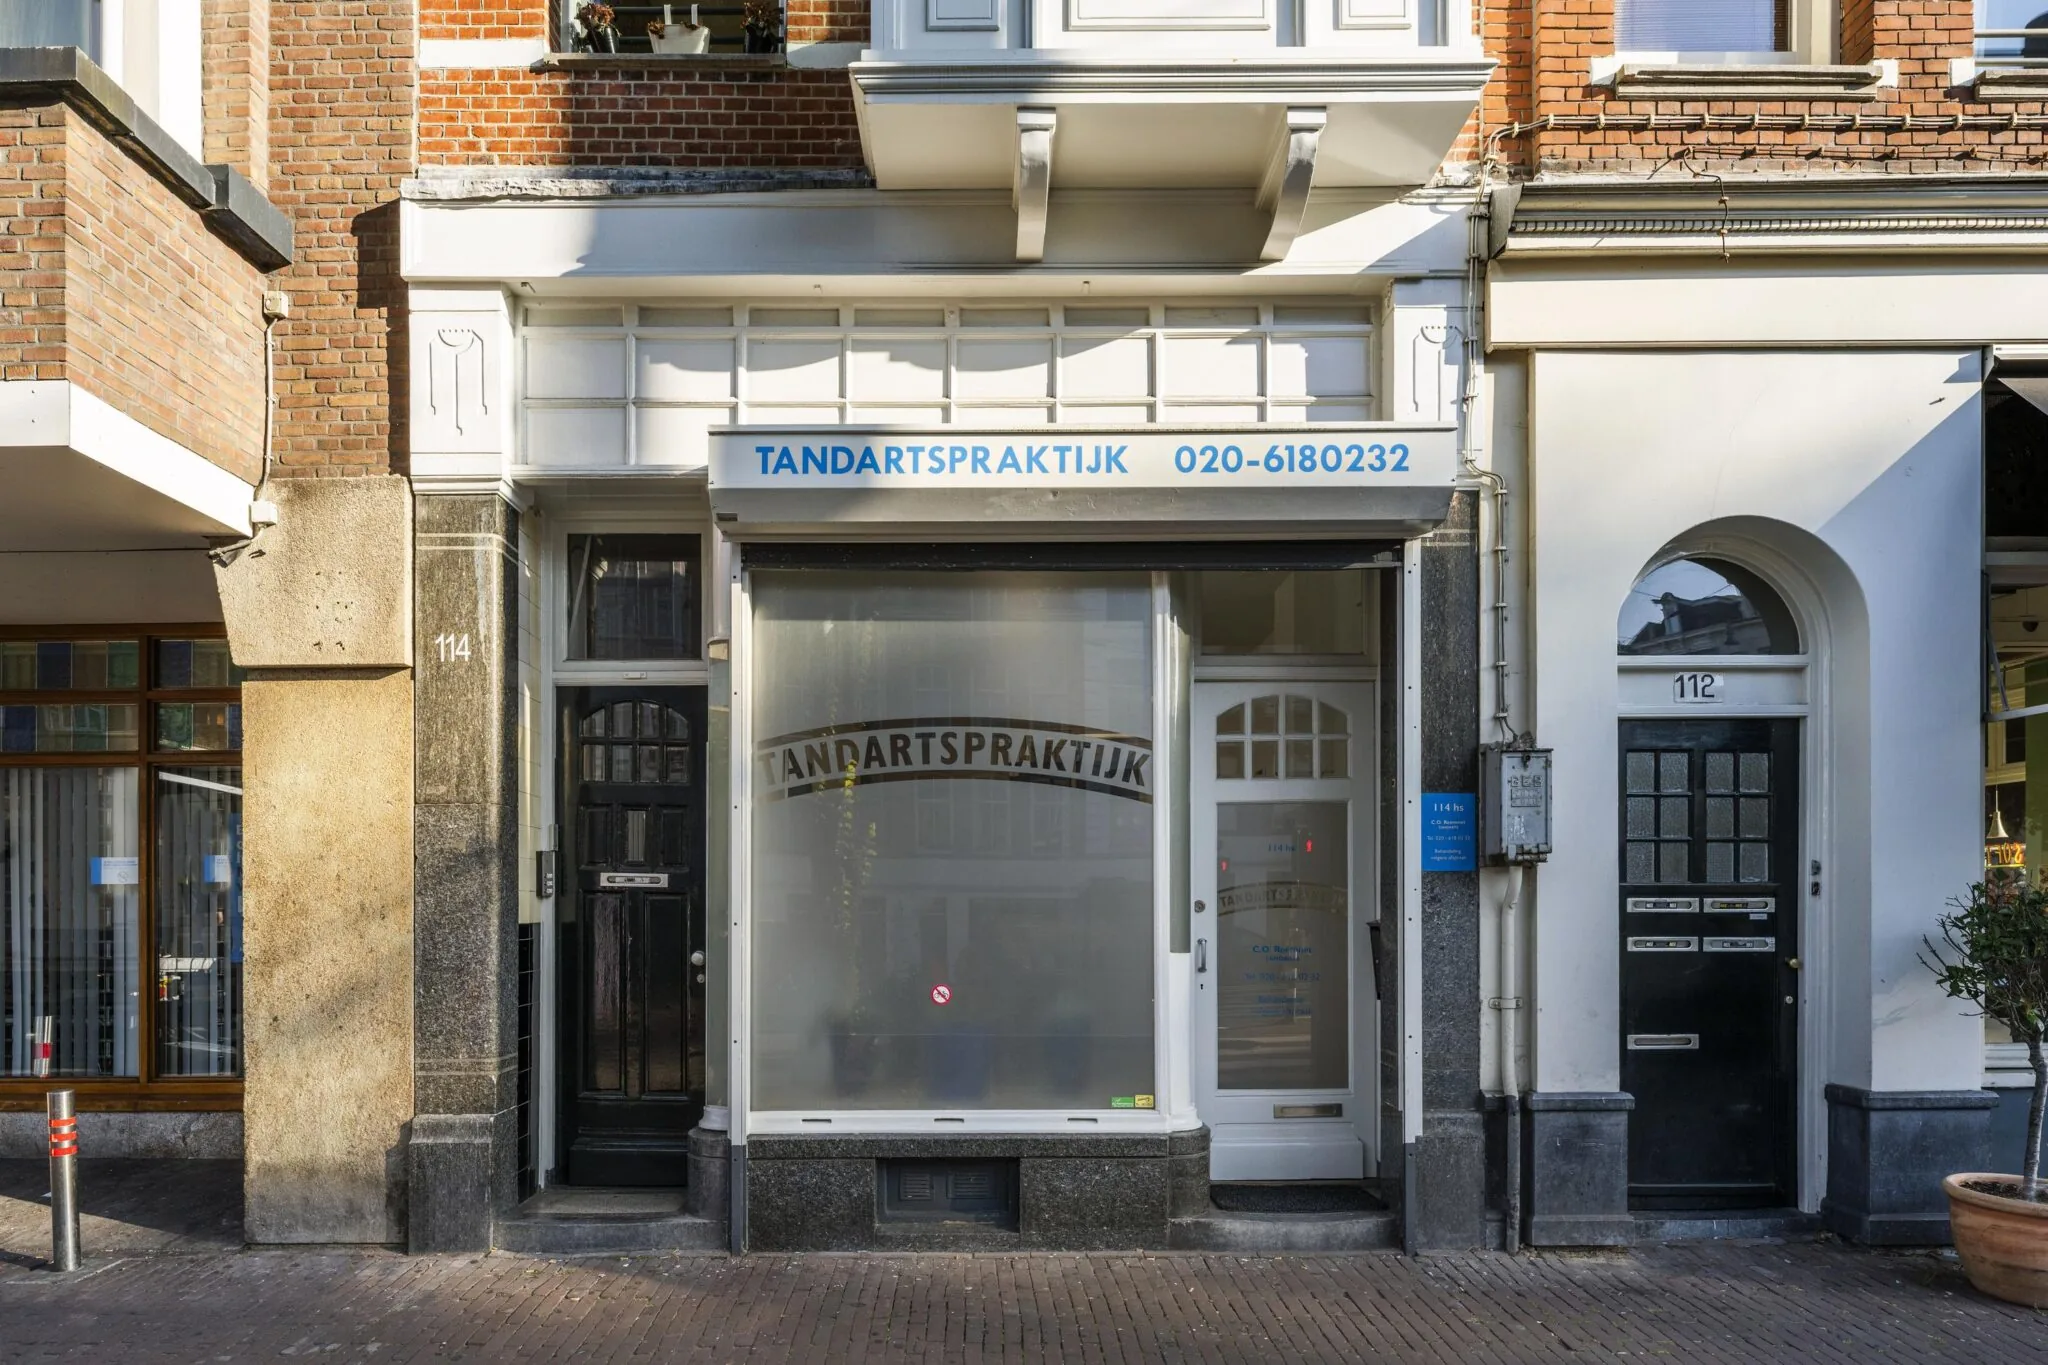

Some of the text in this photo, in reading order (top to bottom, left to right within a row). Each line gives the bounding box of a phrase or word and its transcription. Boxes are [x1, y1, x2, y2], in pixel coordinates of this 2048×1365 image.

[755, 443, 1410, 475] TANDARTSPRAKTIJK 020-6180232
[435, 633, 472, 662] 114
[1675, 674, 1715, 698] 112
[757, 731, 1151, 787] TANDARTSPRAKTIJK
[1434, 803, 1465, 812] 114 hs
